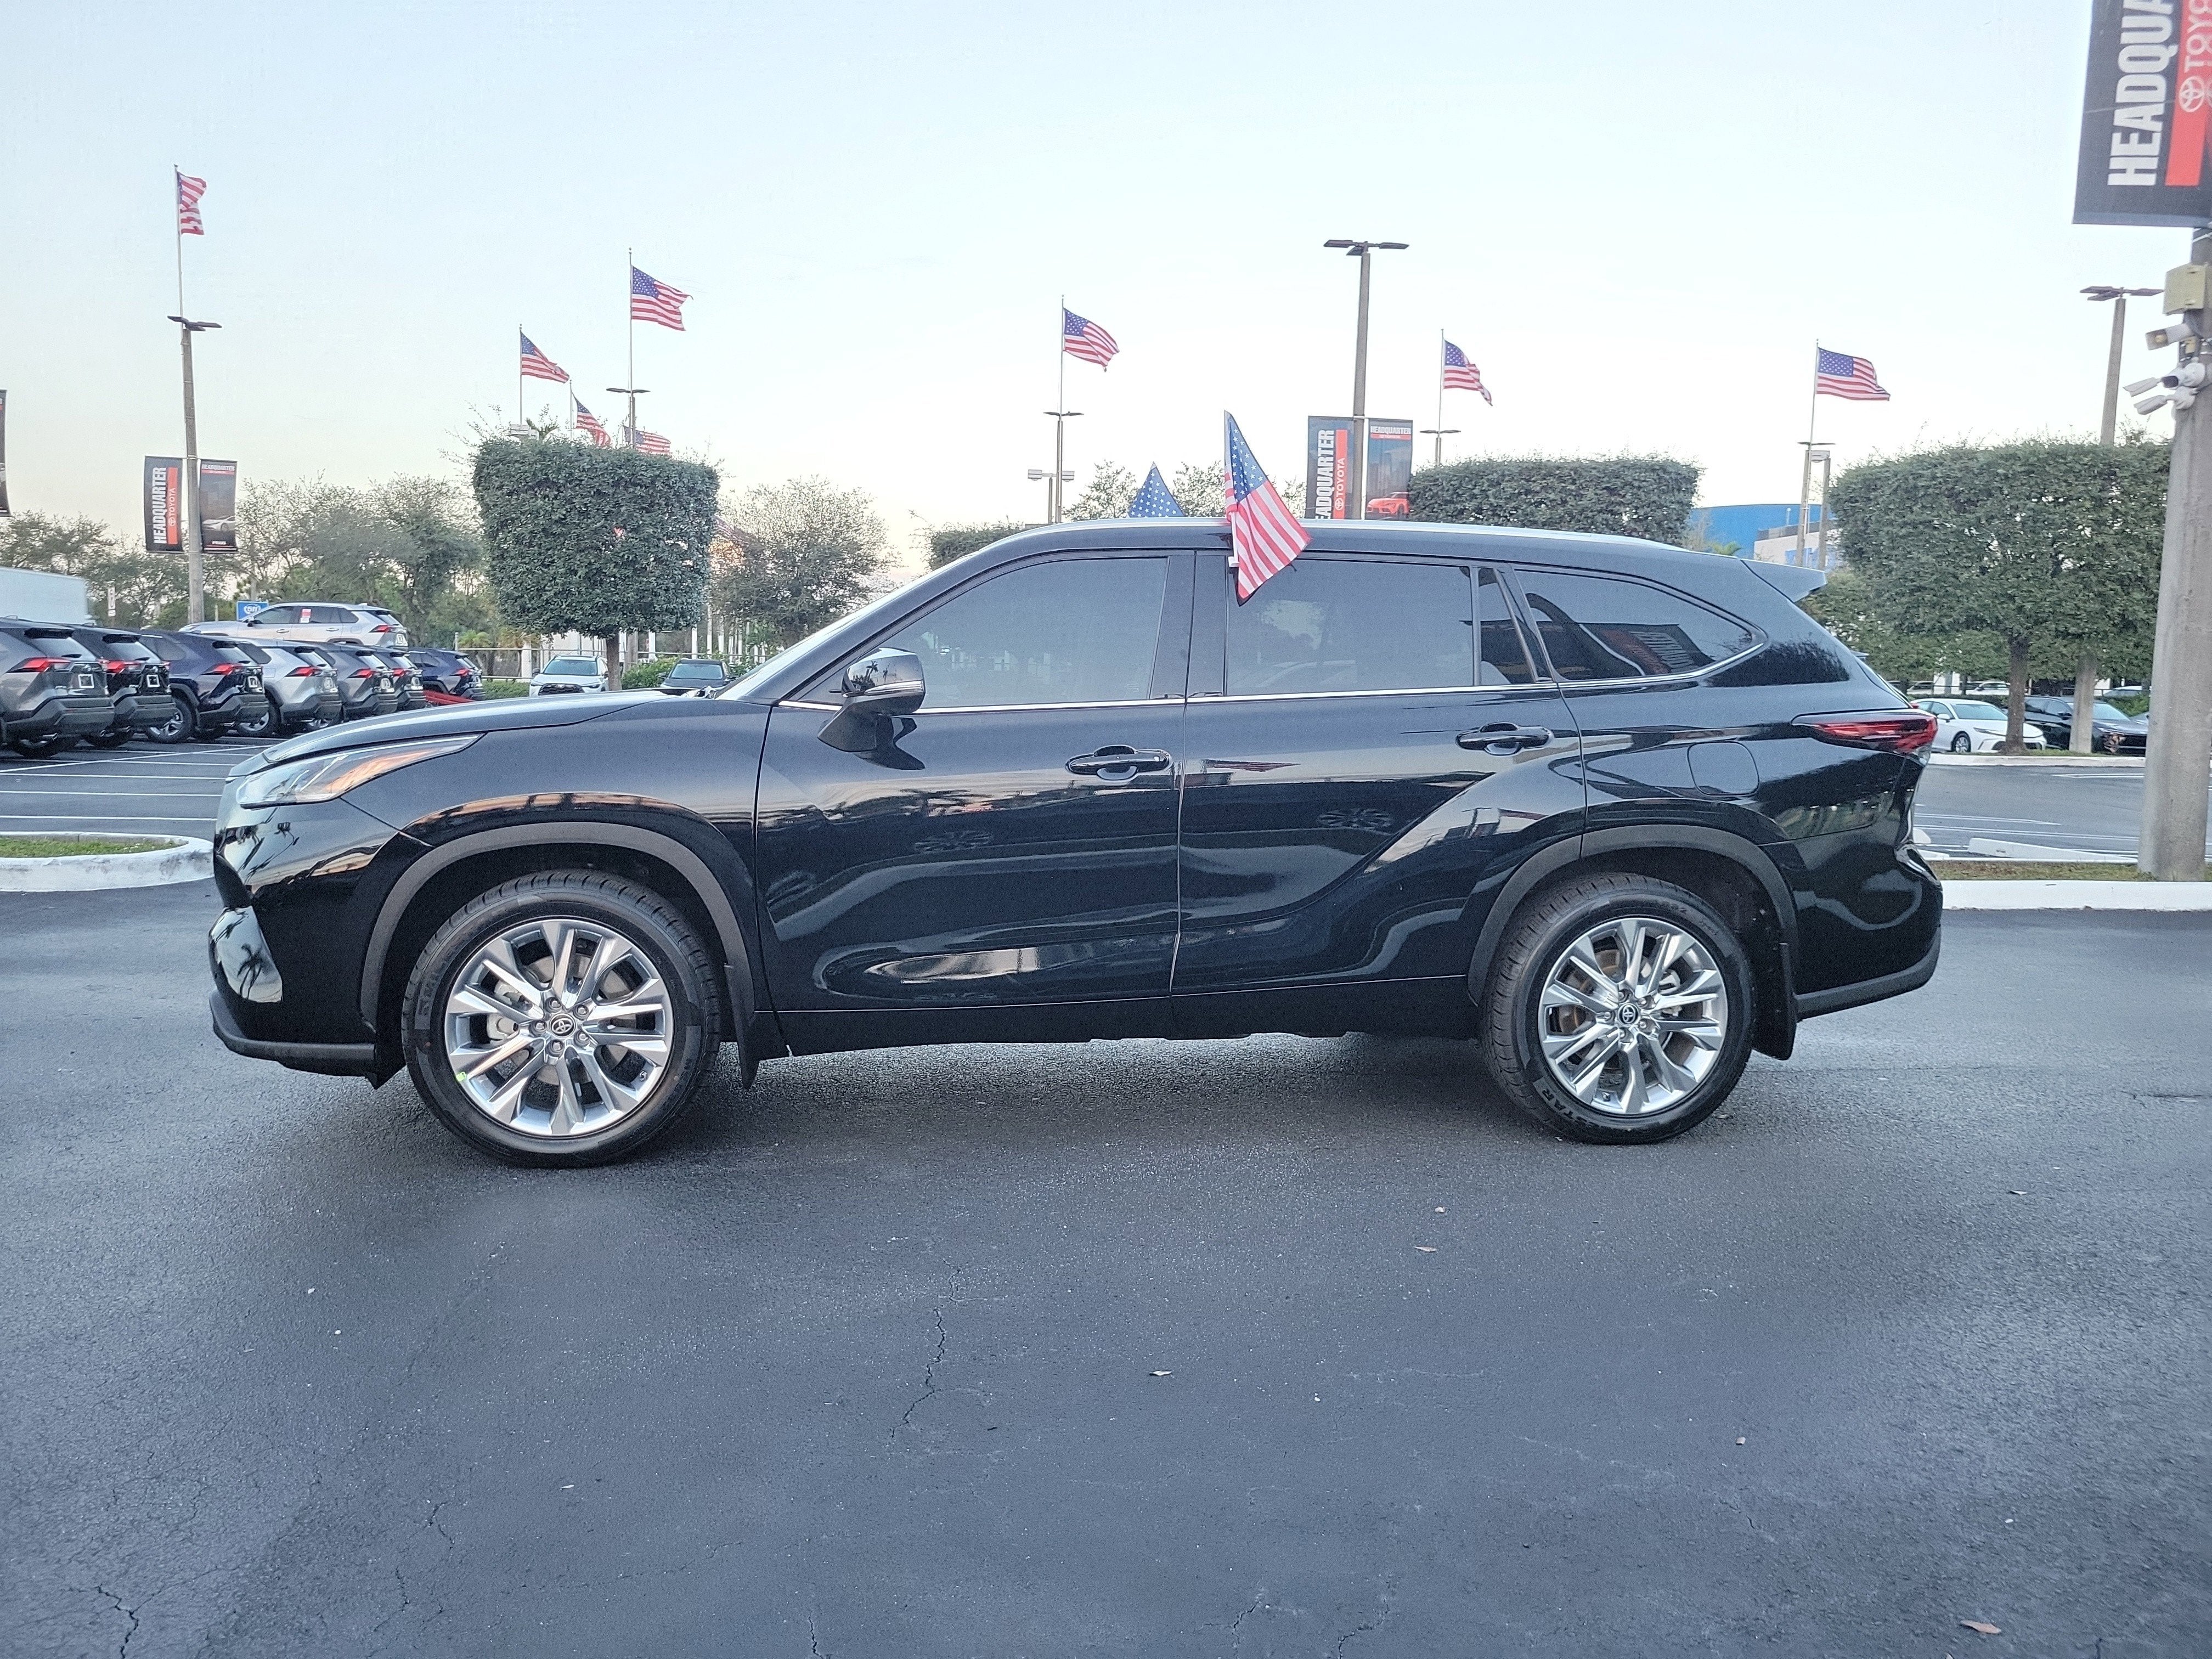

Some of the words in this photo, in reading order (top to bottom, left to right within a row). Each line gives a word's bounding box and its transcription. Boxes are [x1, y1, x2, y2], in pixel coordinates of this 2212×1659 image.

[152, 467, 167, 544] HEADQUARTER
[1315, 430, 1335, 519] ADQUARTER
[1336, 458, 1345, 498] TOYOTA
